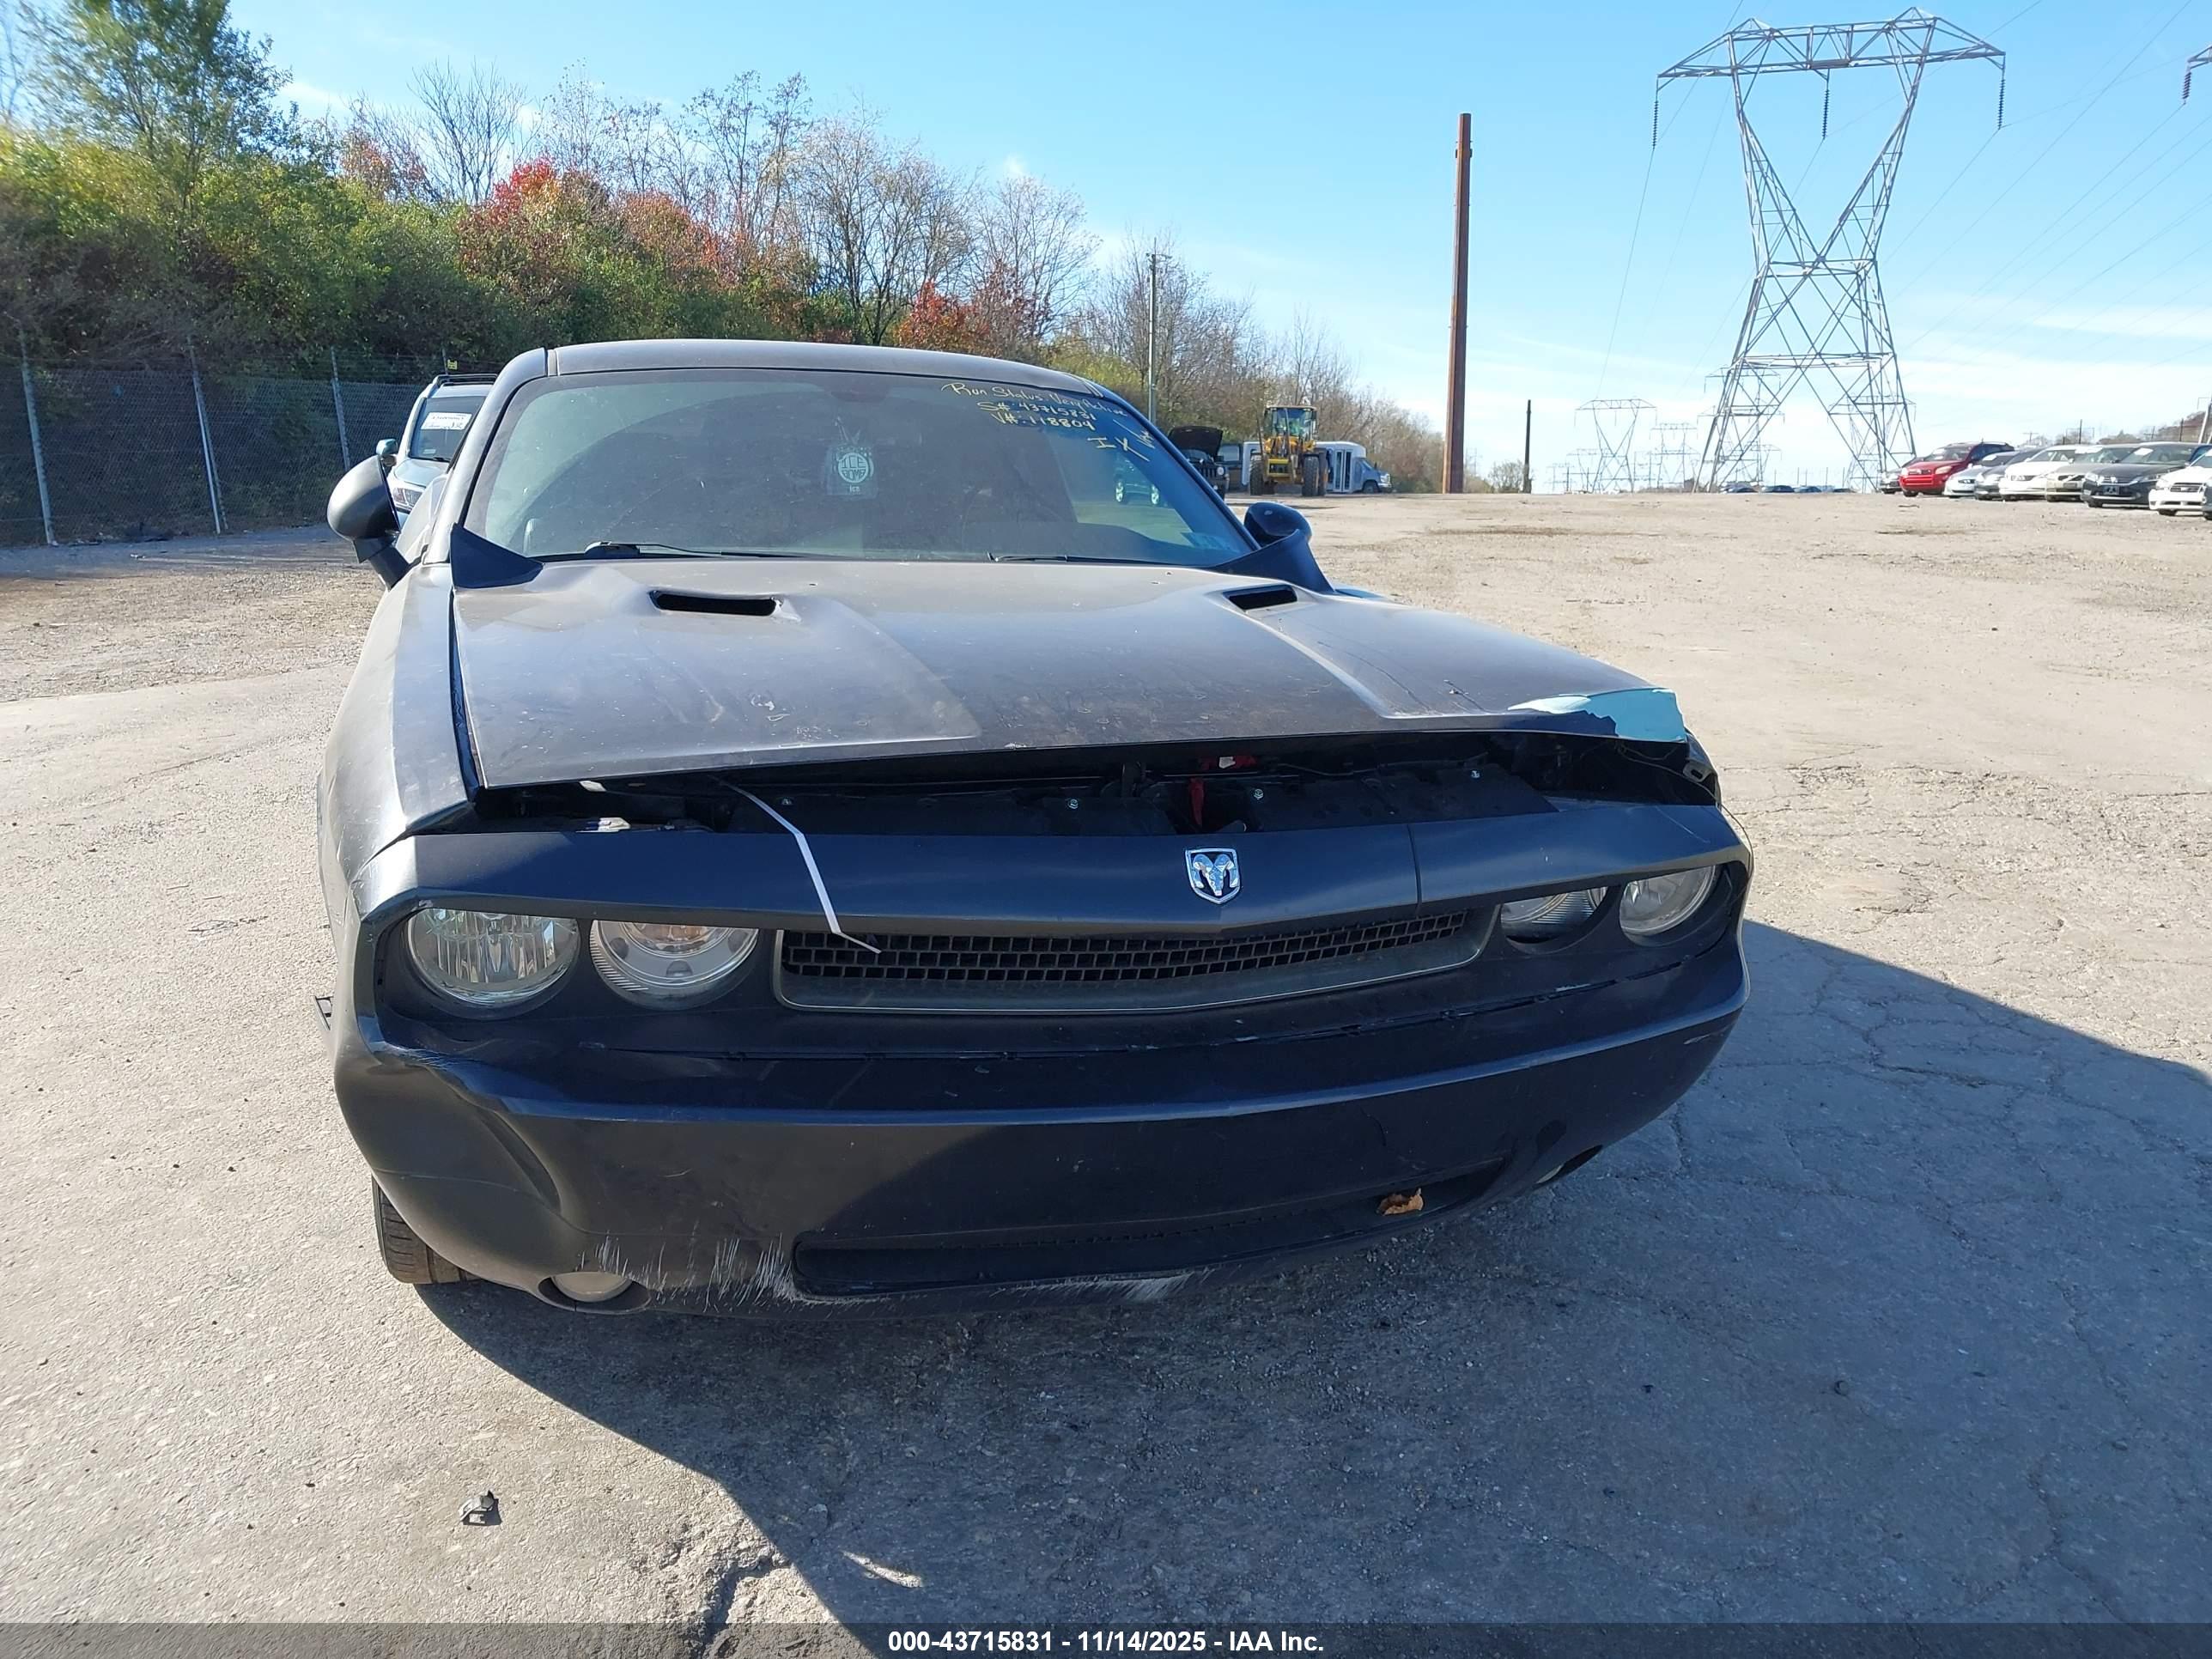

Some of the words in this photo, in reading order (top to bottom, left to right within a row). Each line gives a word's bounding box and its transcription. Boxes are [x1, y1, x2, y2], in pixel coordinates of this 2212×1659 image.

[941, 382, 988, 396] Run
[1048, 392, 1087, 413] Very
[1018, 402, 1097, 421] 43715831
[1030, 415, 1096, 431] 118804
[842, 455, 866, 469] ICE
